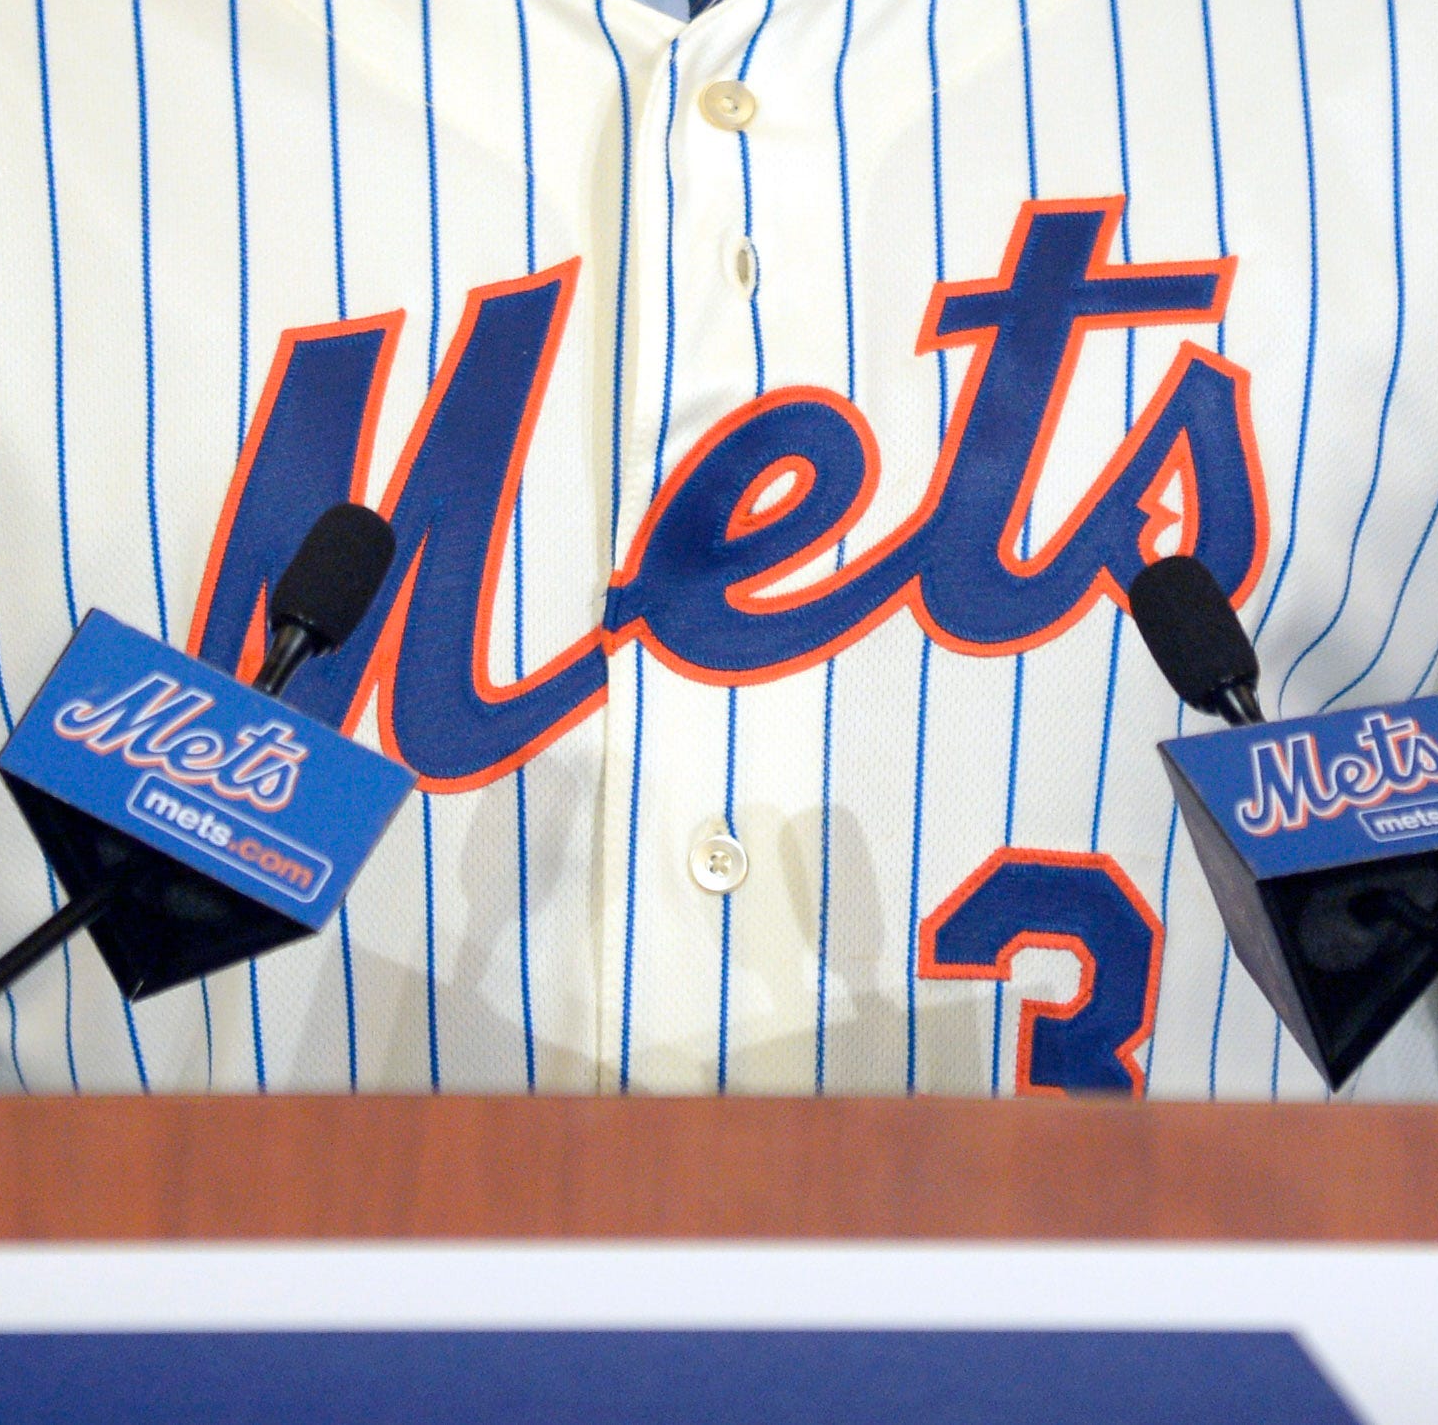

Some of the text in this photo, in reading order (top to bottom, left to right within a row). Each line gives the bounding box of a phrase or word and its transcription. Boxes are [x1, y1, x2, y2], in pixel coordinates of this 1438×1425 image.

[184, 195, 1271, 794] Mets
[53, 671, 308, 812] Mets
[143, 788, 314, 889] mets.com
